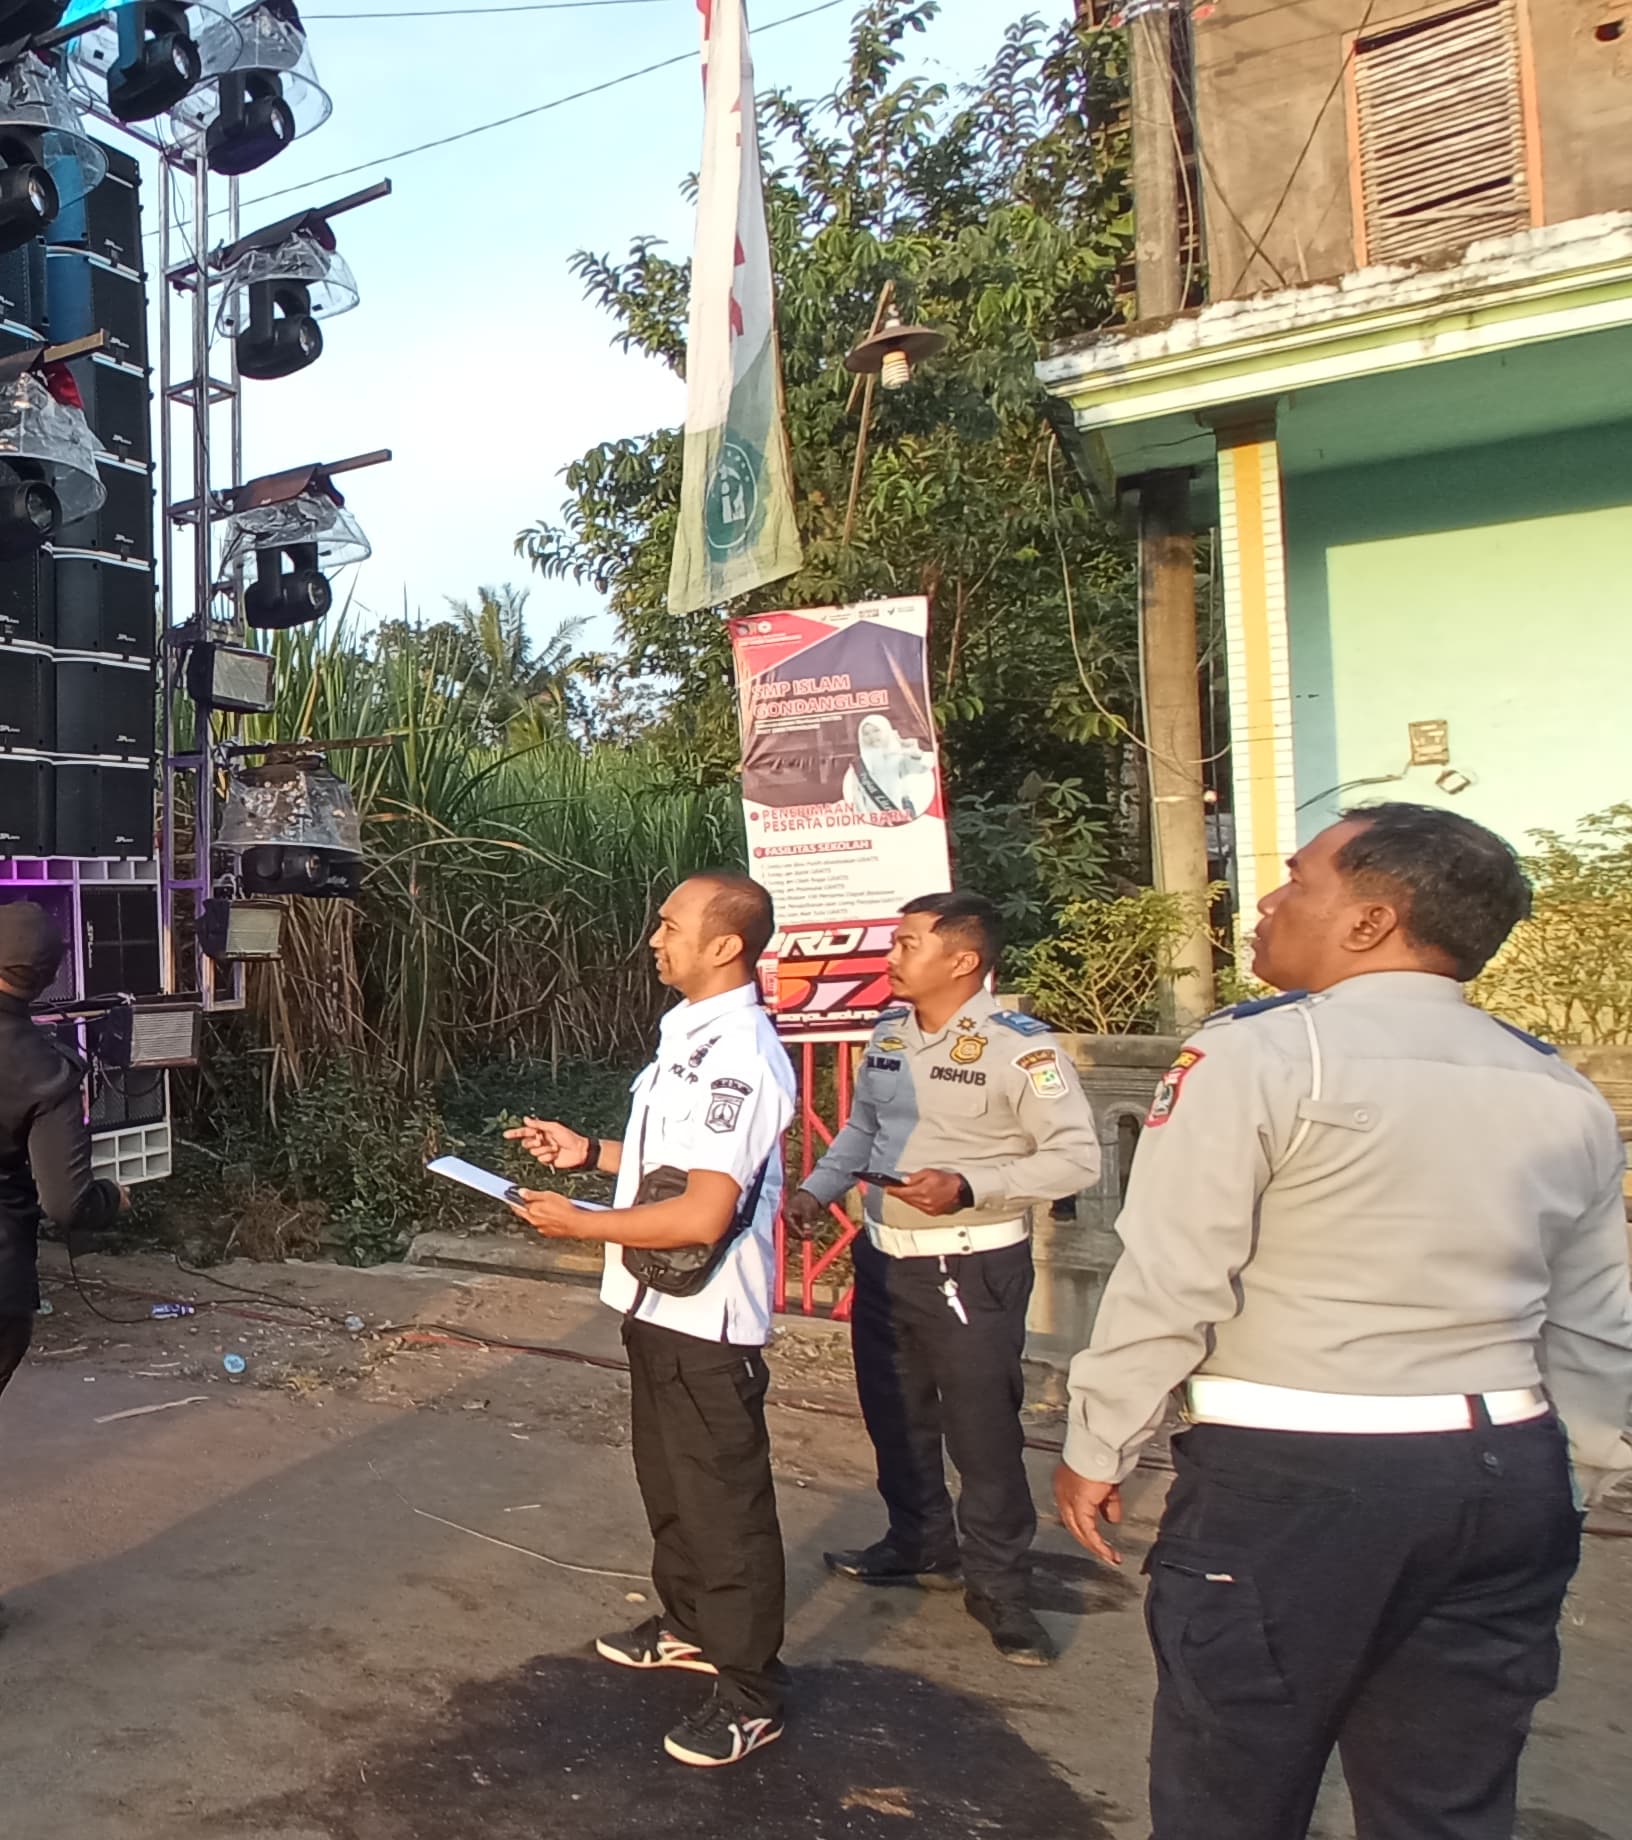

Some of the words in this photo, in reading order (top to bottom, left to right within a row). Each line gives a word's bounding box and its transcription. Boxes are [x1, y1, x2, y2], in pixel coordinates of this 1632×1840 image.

[792, 674, 851, 695] ISLAM
[753, 689, 888, 719] GONDANGLEGI
[764, 817, 823, 832] PESERTA
[826, 813, 865, 828] DIDIK
[817, 840, 869, 852] SEKOLAH
[929, 1066, 987, 1086] DISHUB
